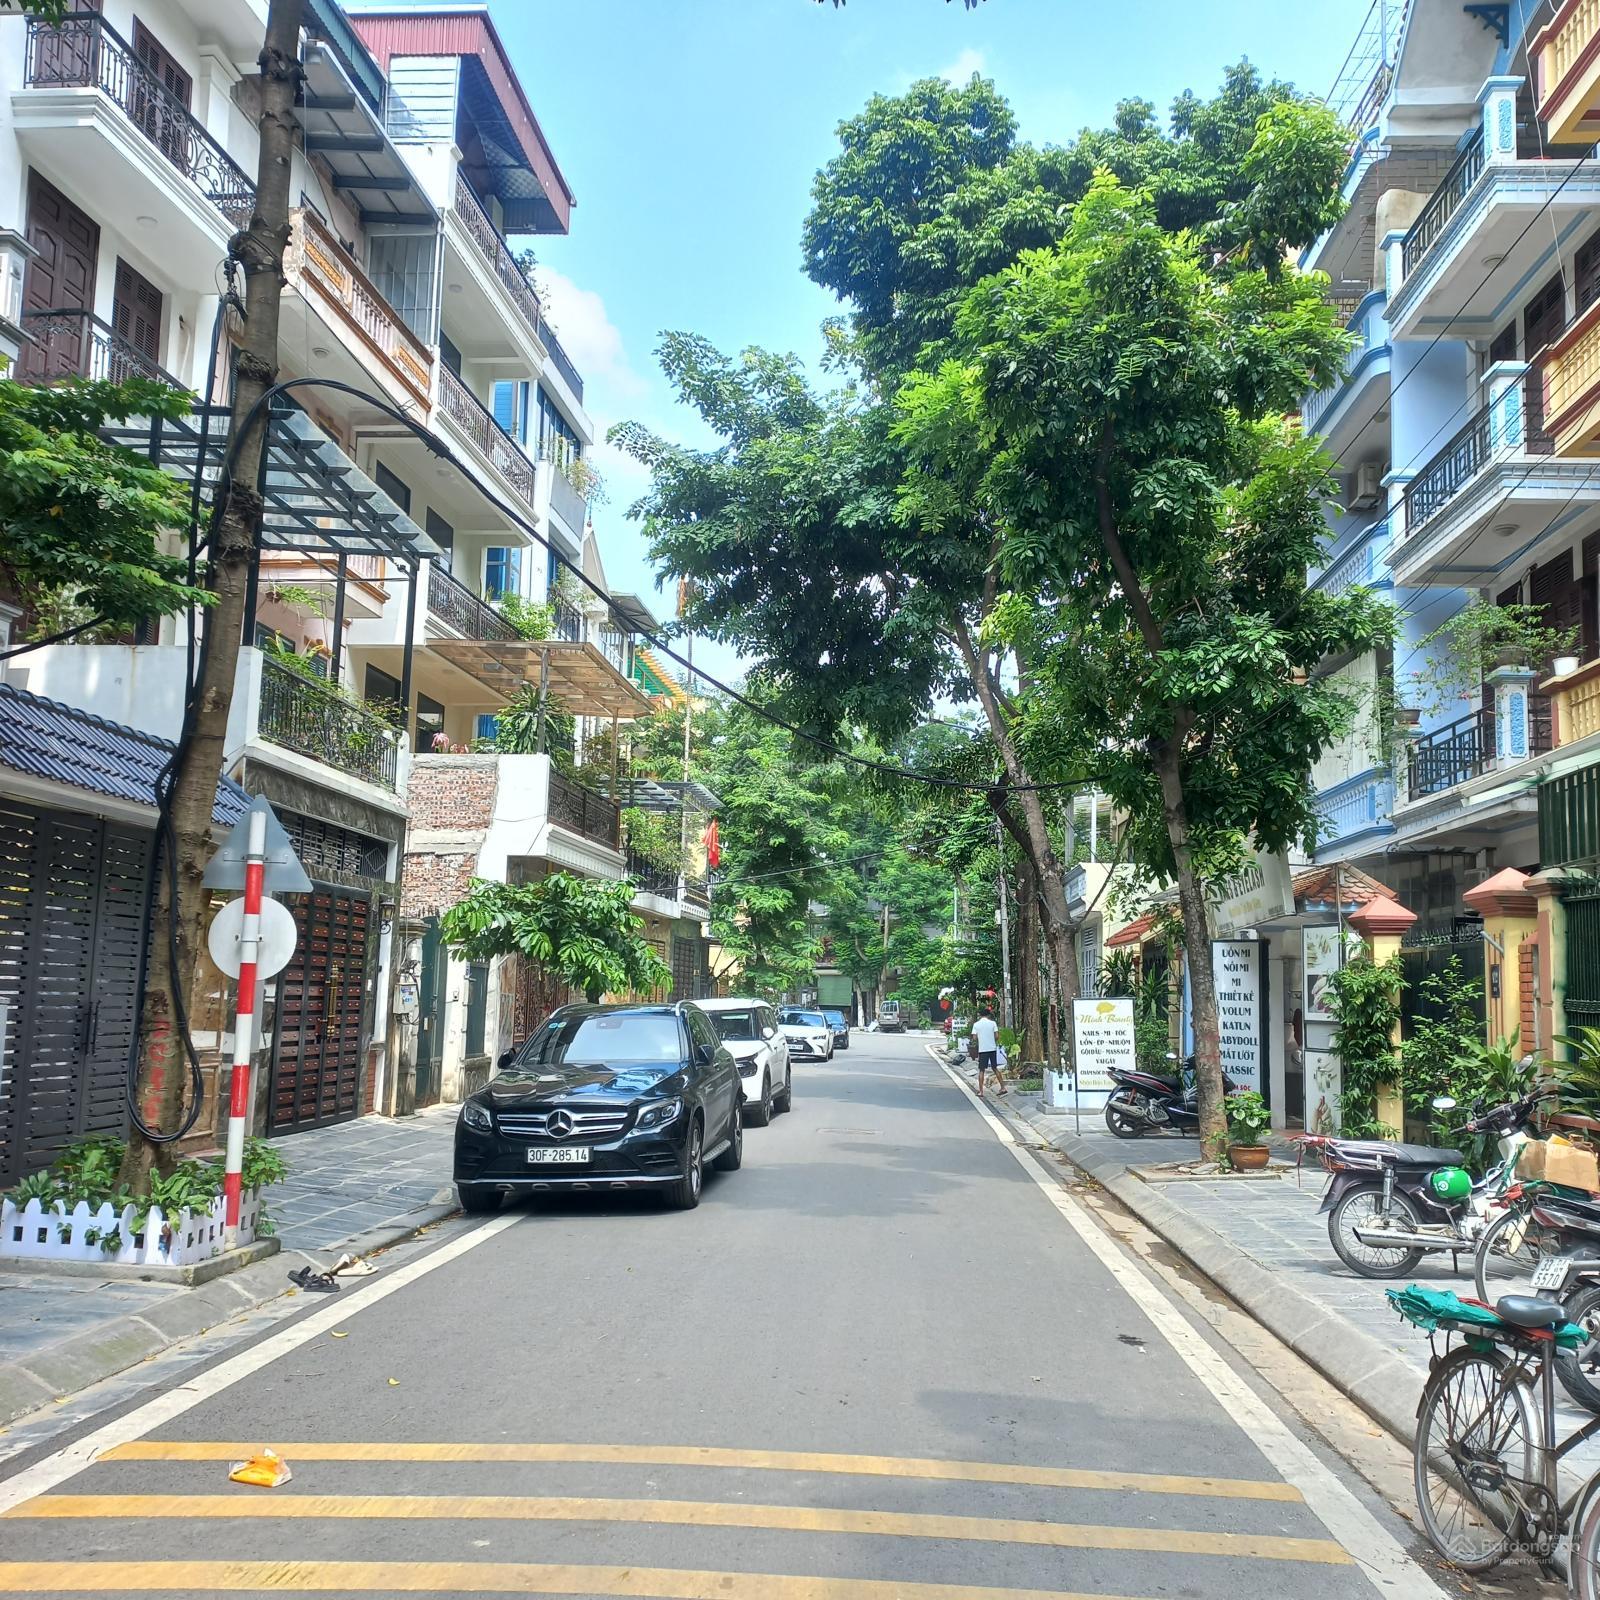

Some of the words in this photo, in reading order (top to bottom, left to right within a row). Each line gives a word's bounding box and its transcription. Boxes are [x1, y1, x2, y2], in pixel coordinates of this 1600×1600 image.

[1222, 946, 1240, 957] UỐN
[1241, 949, 1250, 957] MI
[1223, 961, 1238, 972] NỐI
[1240, 964, 1249, 972] MI
[1232, 978, 1241, 986] MI
[1219, 990, 1242, 1001] THIẾT
[1243, 990, 1254, 1001] KẾ
[1222, 1007, 1251, 1016] VOLUM
[1222, 1021, 1251, 1030] KATUN
[1218, 1036, 1259, 1046] ABYDOLL
[529, 1149, 587, 1162] 30F-285.14
